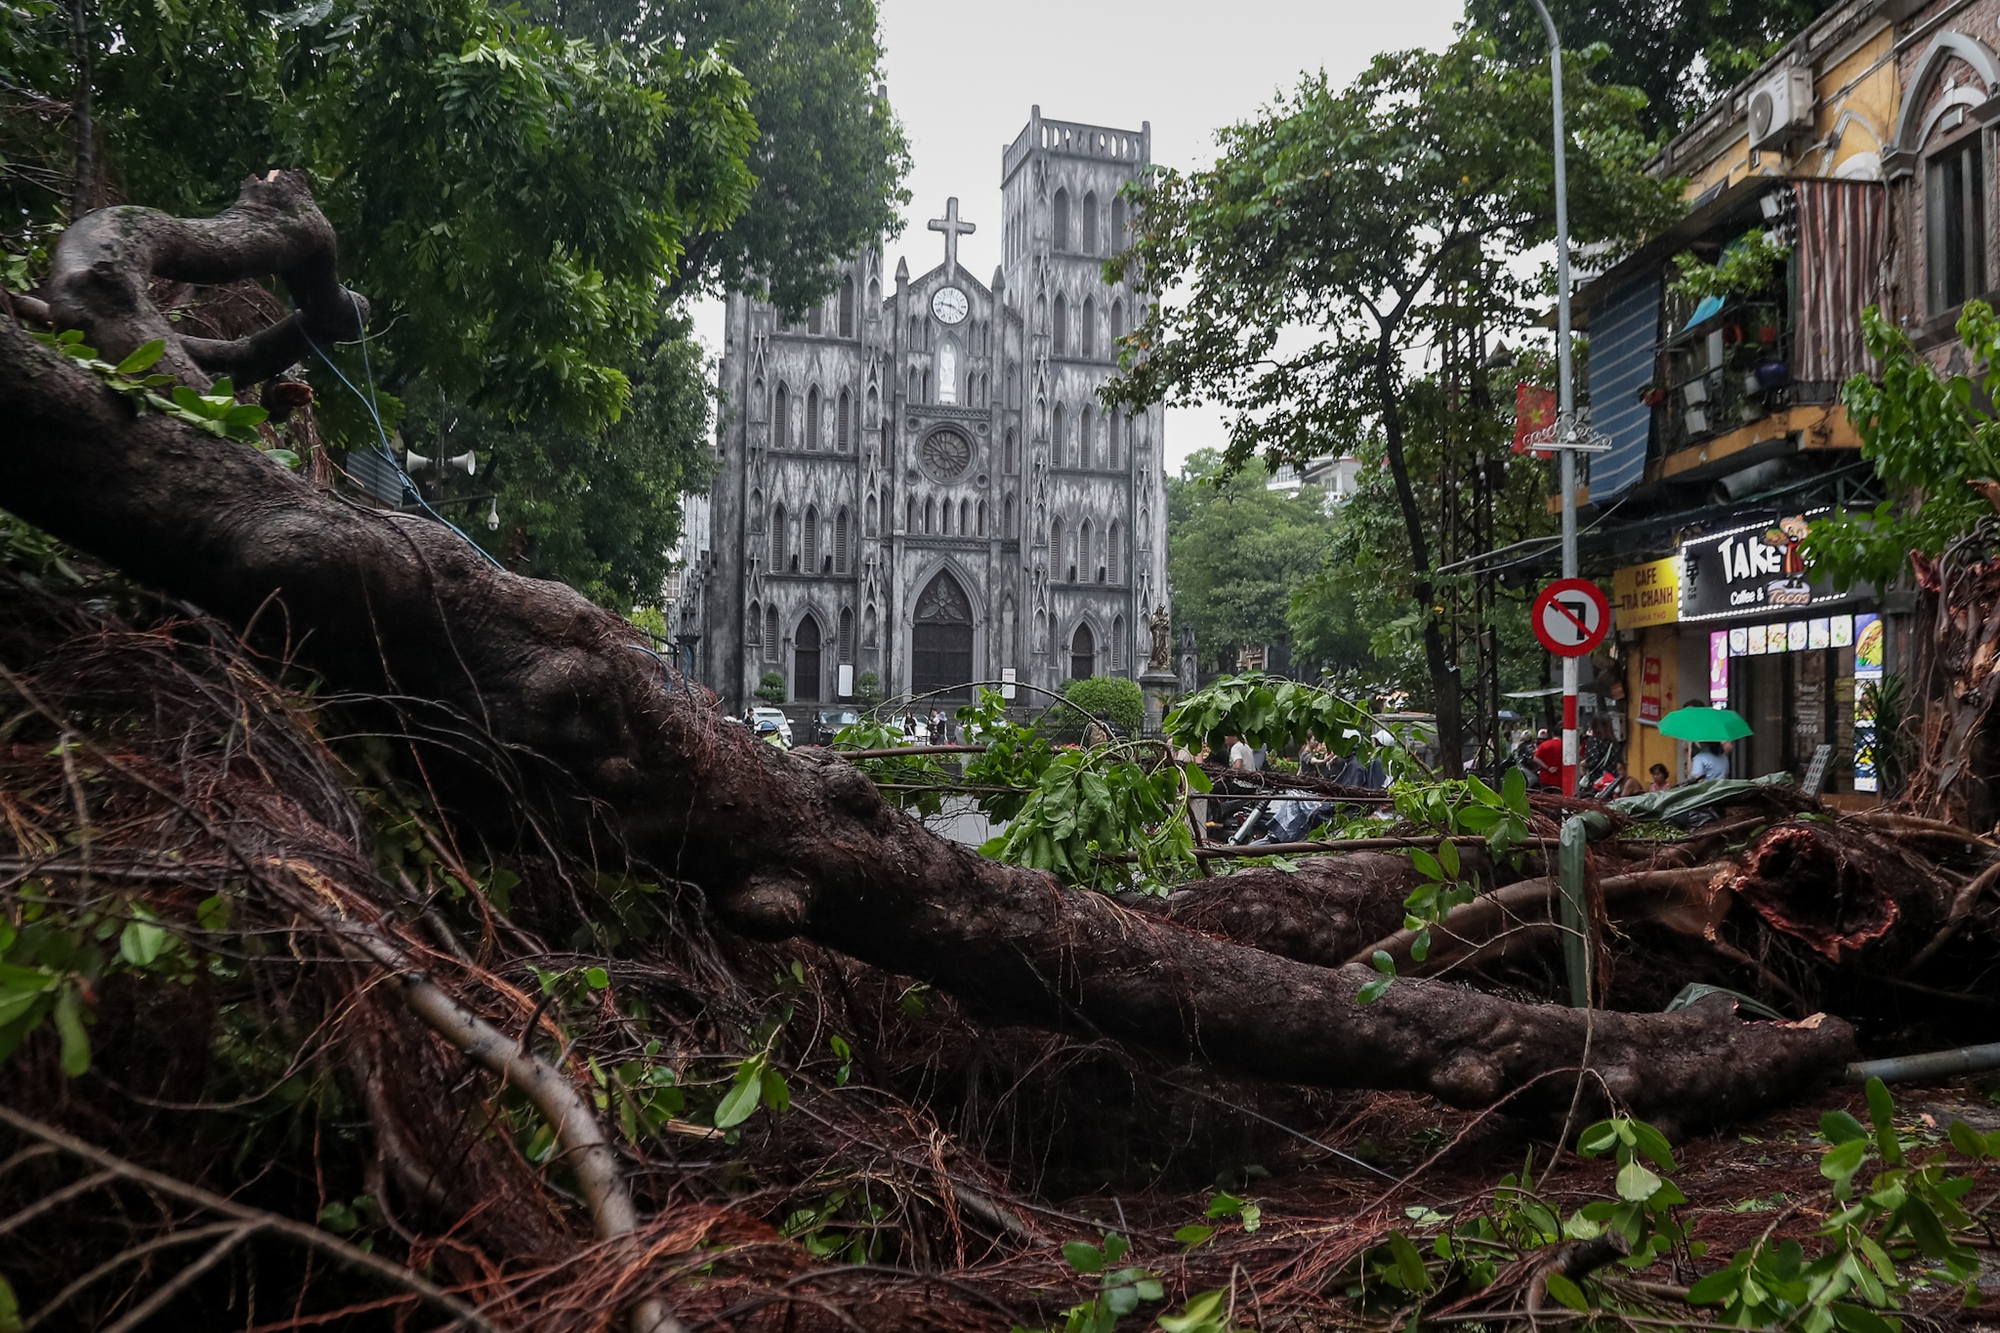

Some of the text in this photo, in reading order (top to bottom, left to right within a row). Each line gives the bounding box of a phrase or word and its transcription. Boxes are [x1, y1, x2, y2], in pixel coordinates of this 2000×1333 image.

[1718, 535, 1781, 584] TAKE
[1635, 567, 1657, 587] CAFE
[1641, 586, 1674, 608] CHANH
[1730, 587, 1810, 606] Coffee & Tacos
